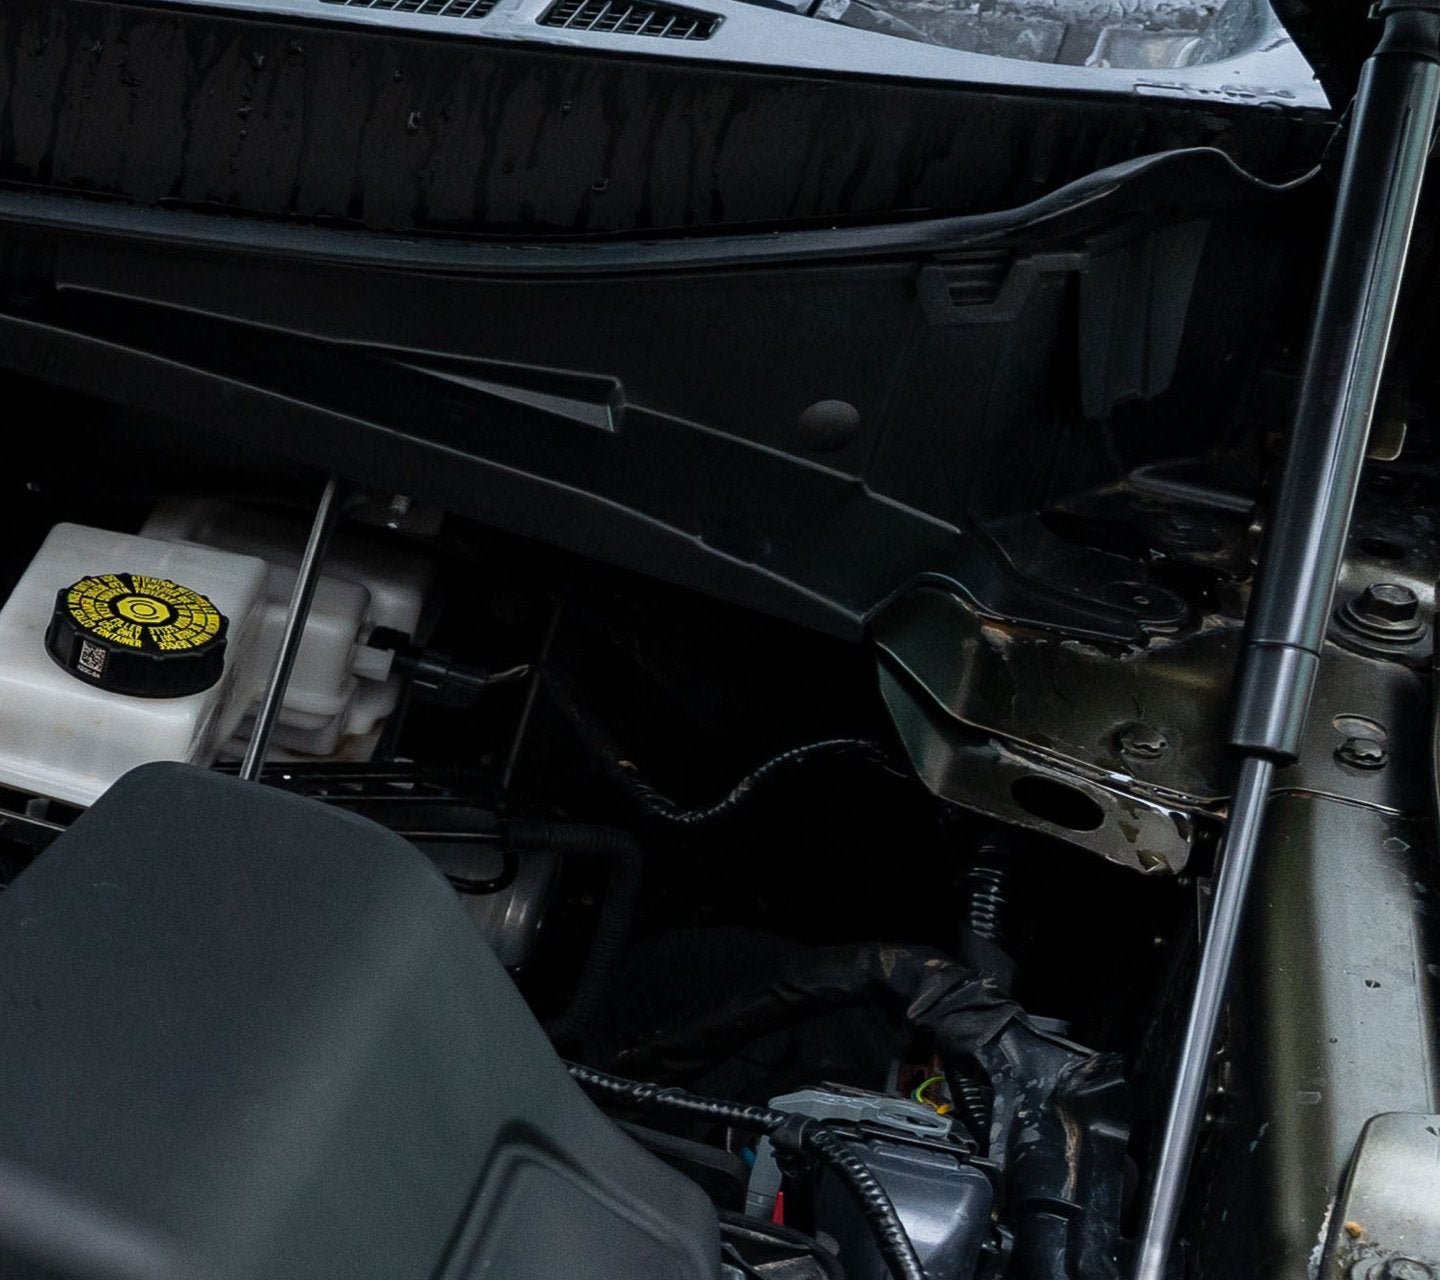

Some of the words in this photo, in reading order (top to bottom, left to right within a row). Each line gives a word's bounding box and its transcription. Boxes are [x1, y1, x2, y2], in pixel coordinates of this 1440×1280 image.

[109, 617, 142, 634] FILLER
[117, 628, 140, 640] ONLY
[92, 627, 142, 648] CONTAINER
